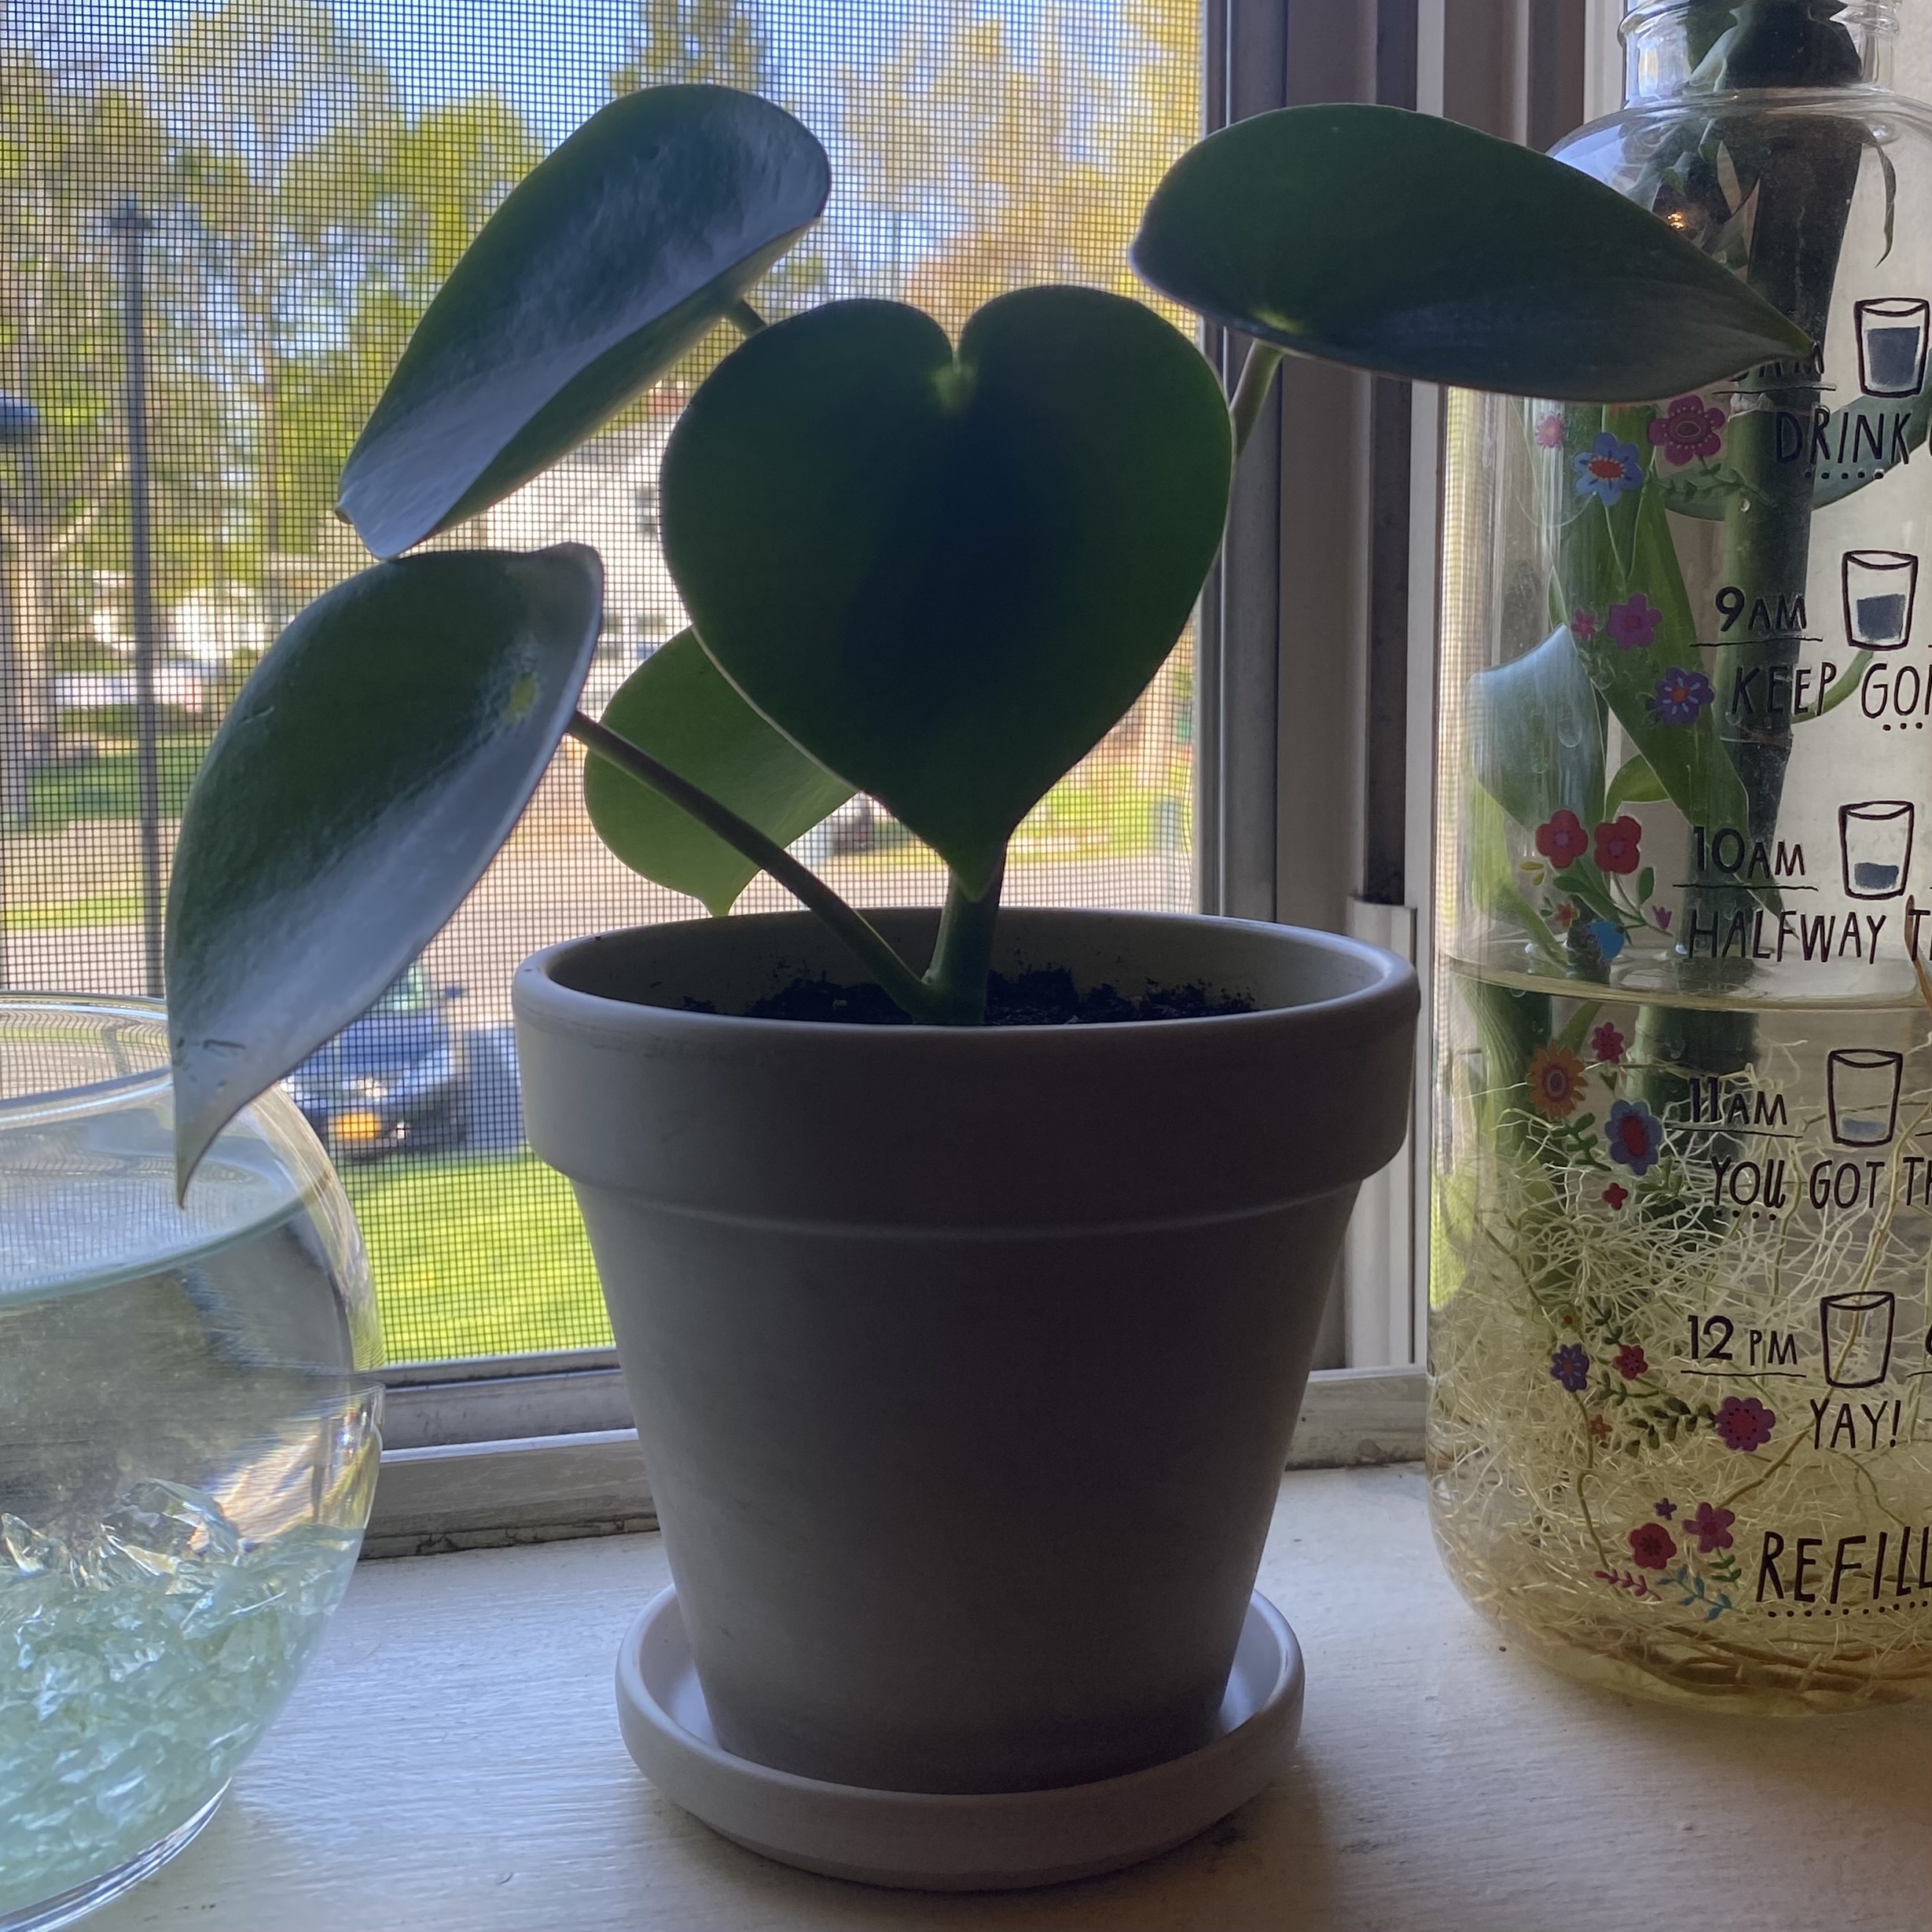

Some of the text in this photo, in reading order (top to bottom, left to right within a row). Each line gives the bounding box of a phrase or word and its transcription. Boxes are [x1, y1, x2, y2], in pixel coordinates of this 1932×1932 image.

[1776, 407, 1912, 465] DRINK
[1715, 586, 1807, 632] 9AM
[1732, 662, 1837, 716] KEEP
[1693, 826, 1805, 880] 10AM
[1689, 909, 1932, 964] HALFWAY T
[1710, 1155, 1786, 1209] YOU
[1809, 1159, 1886, 1210] GOT
[1809, 1398, 1901, 1450] YAY!
[1755, 1526, 1932, 1604] REFILL
